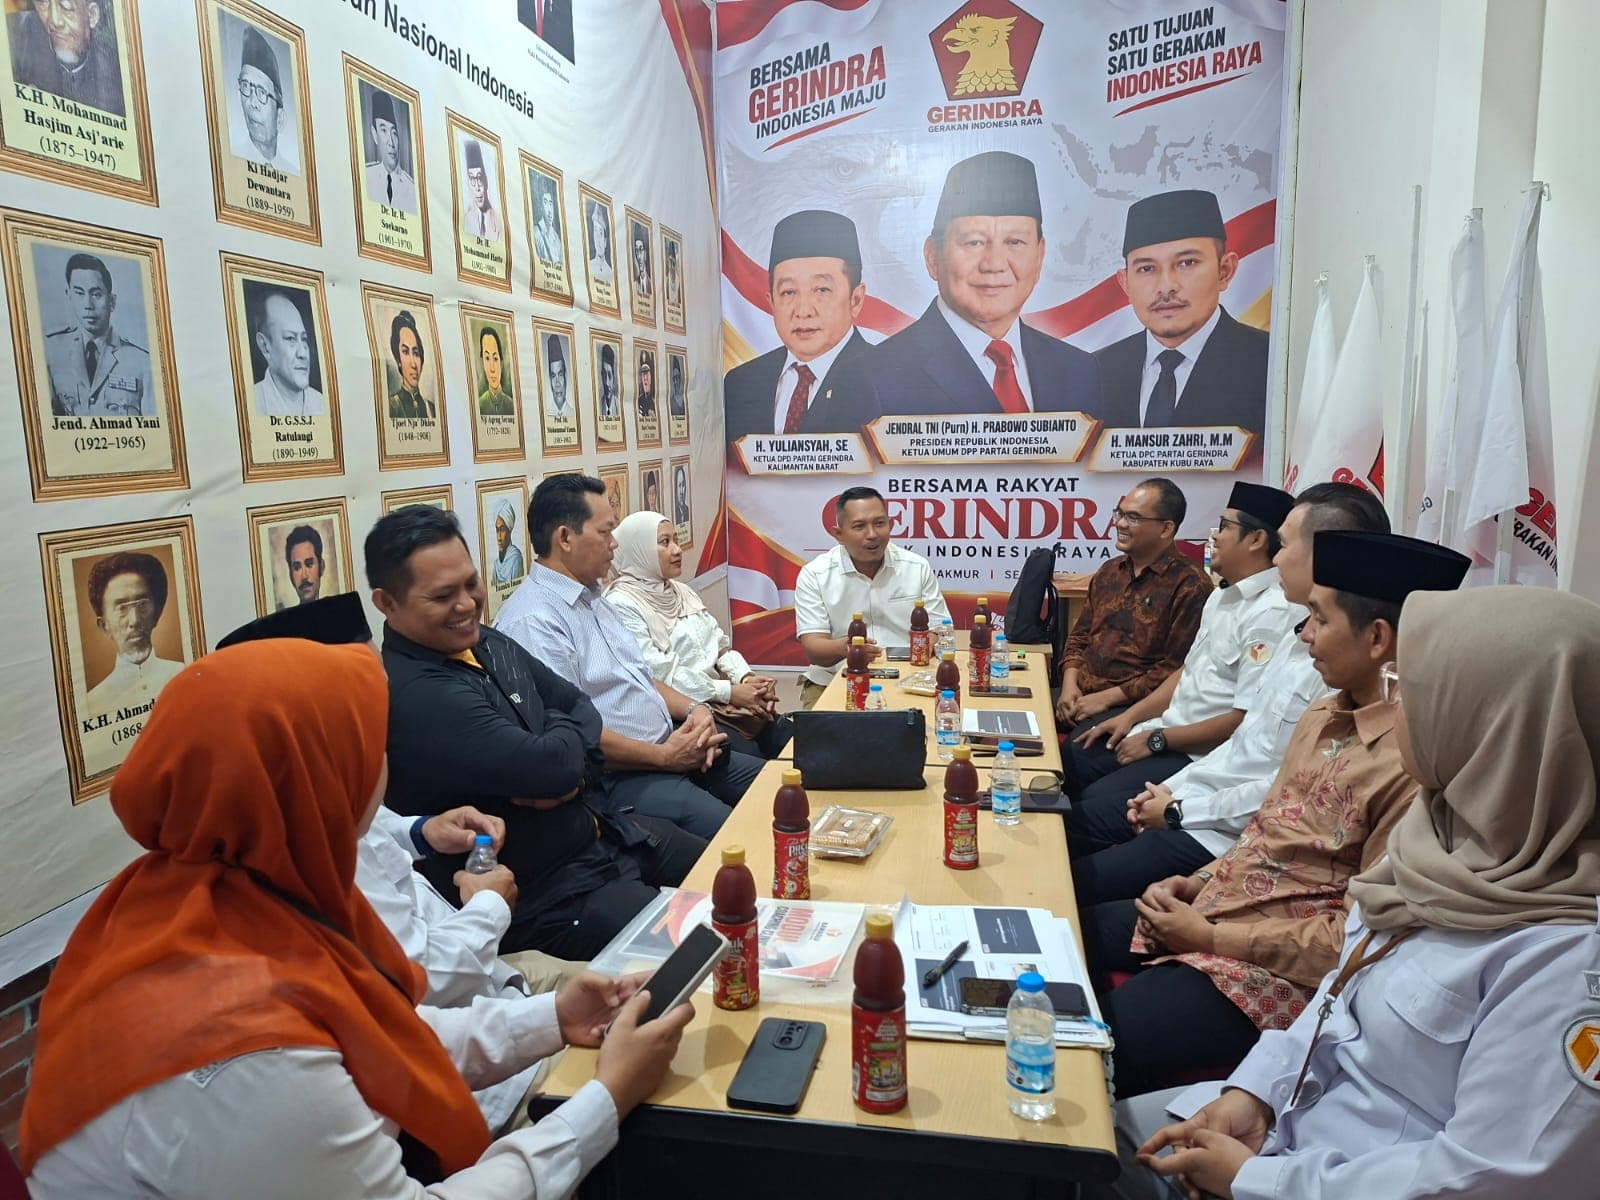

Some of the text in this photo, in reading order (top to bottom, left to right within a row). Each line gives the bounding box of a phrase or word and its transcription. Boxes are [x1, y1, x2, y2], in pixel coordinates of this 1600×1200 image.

[1108, 7, 1214, 52] SATU TUJUAN
[1107, 27, 1226, 75] SATU GERAKAN
[384, 0, 462, 74] Nasional
[466, 53, 534, 119] Indonesia
[750, 42, 830, 89] BERSAMA
[1107, 41, 1262, 103] INDONESIA RAYA
[749, 45, 886, 123] GERINDRA
[14, 84, 127, 131] K.H. Mohammad
[756, 82, 886, 139] INDONESIA MAJU
[927, 99, 1043, 124] GERINDRA
[24, 108, 125, 151] Hasjim Asj'arie
[928, 118, 1043, 133] GERAKAN INDONESIA RAYA
[247, 160, 288, 184] Ki Hadjar
[247, 177, 291, 201] Dewantara
[52, 417, 160, 430] Jend. Ahmad Yani
[270, 415, 283, 427] Dr.
[885, 419, 1077, 435] JENDRAL TNI (Purn) H. PRABOWO SUBIANTO
[275, 431, 314, 443] Ratulangi
[910, 436, 1049, 447] PRESIDEN REPUBLIK INDONESIA
[1111, 433, 1233, 448] H. MANSUR ZAHRI, M.M
[755, 439, 848, 454] H. YULIANSYAH, SE
[901, 446, 1058, 457] KETUA UMUM DPP PARTAI GERINDRA
[1110, 450, 1228, 459] KETUA DPC PARTAI GERINDRA
[818, 454, 854, 462] GERINDRA
[1123, 459, 1214, 468] KABUPATEN KUBU RAYA
[767, 463, 839, 471] KALIMANTAN BARAT
[888, 477, 1080, 493] BERSAMA RAKYAT
[927, 545, 1034, 558] INDONESI
[1057, 545, 1111, 558] RAYA
[933, 569, 979, 579] AKMUR
[82, 698, 156, 733] K.H. Ahmad
